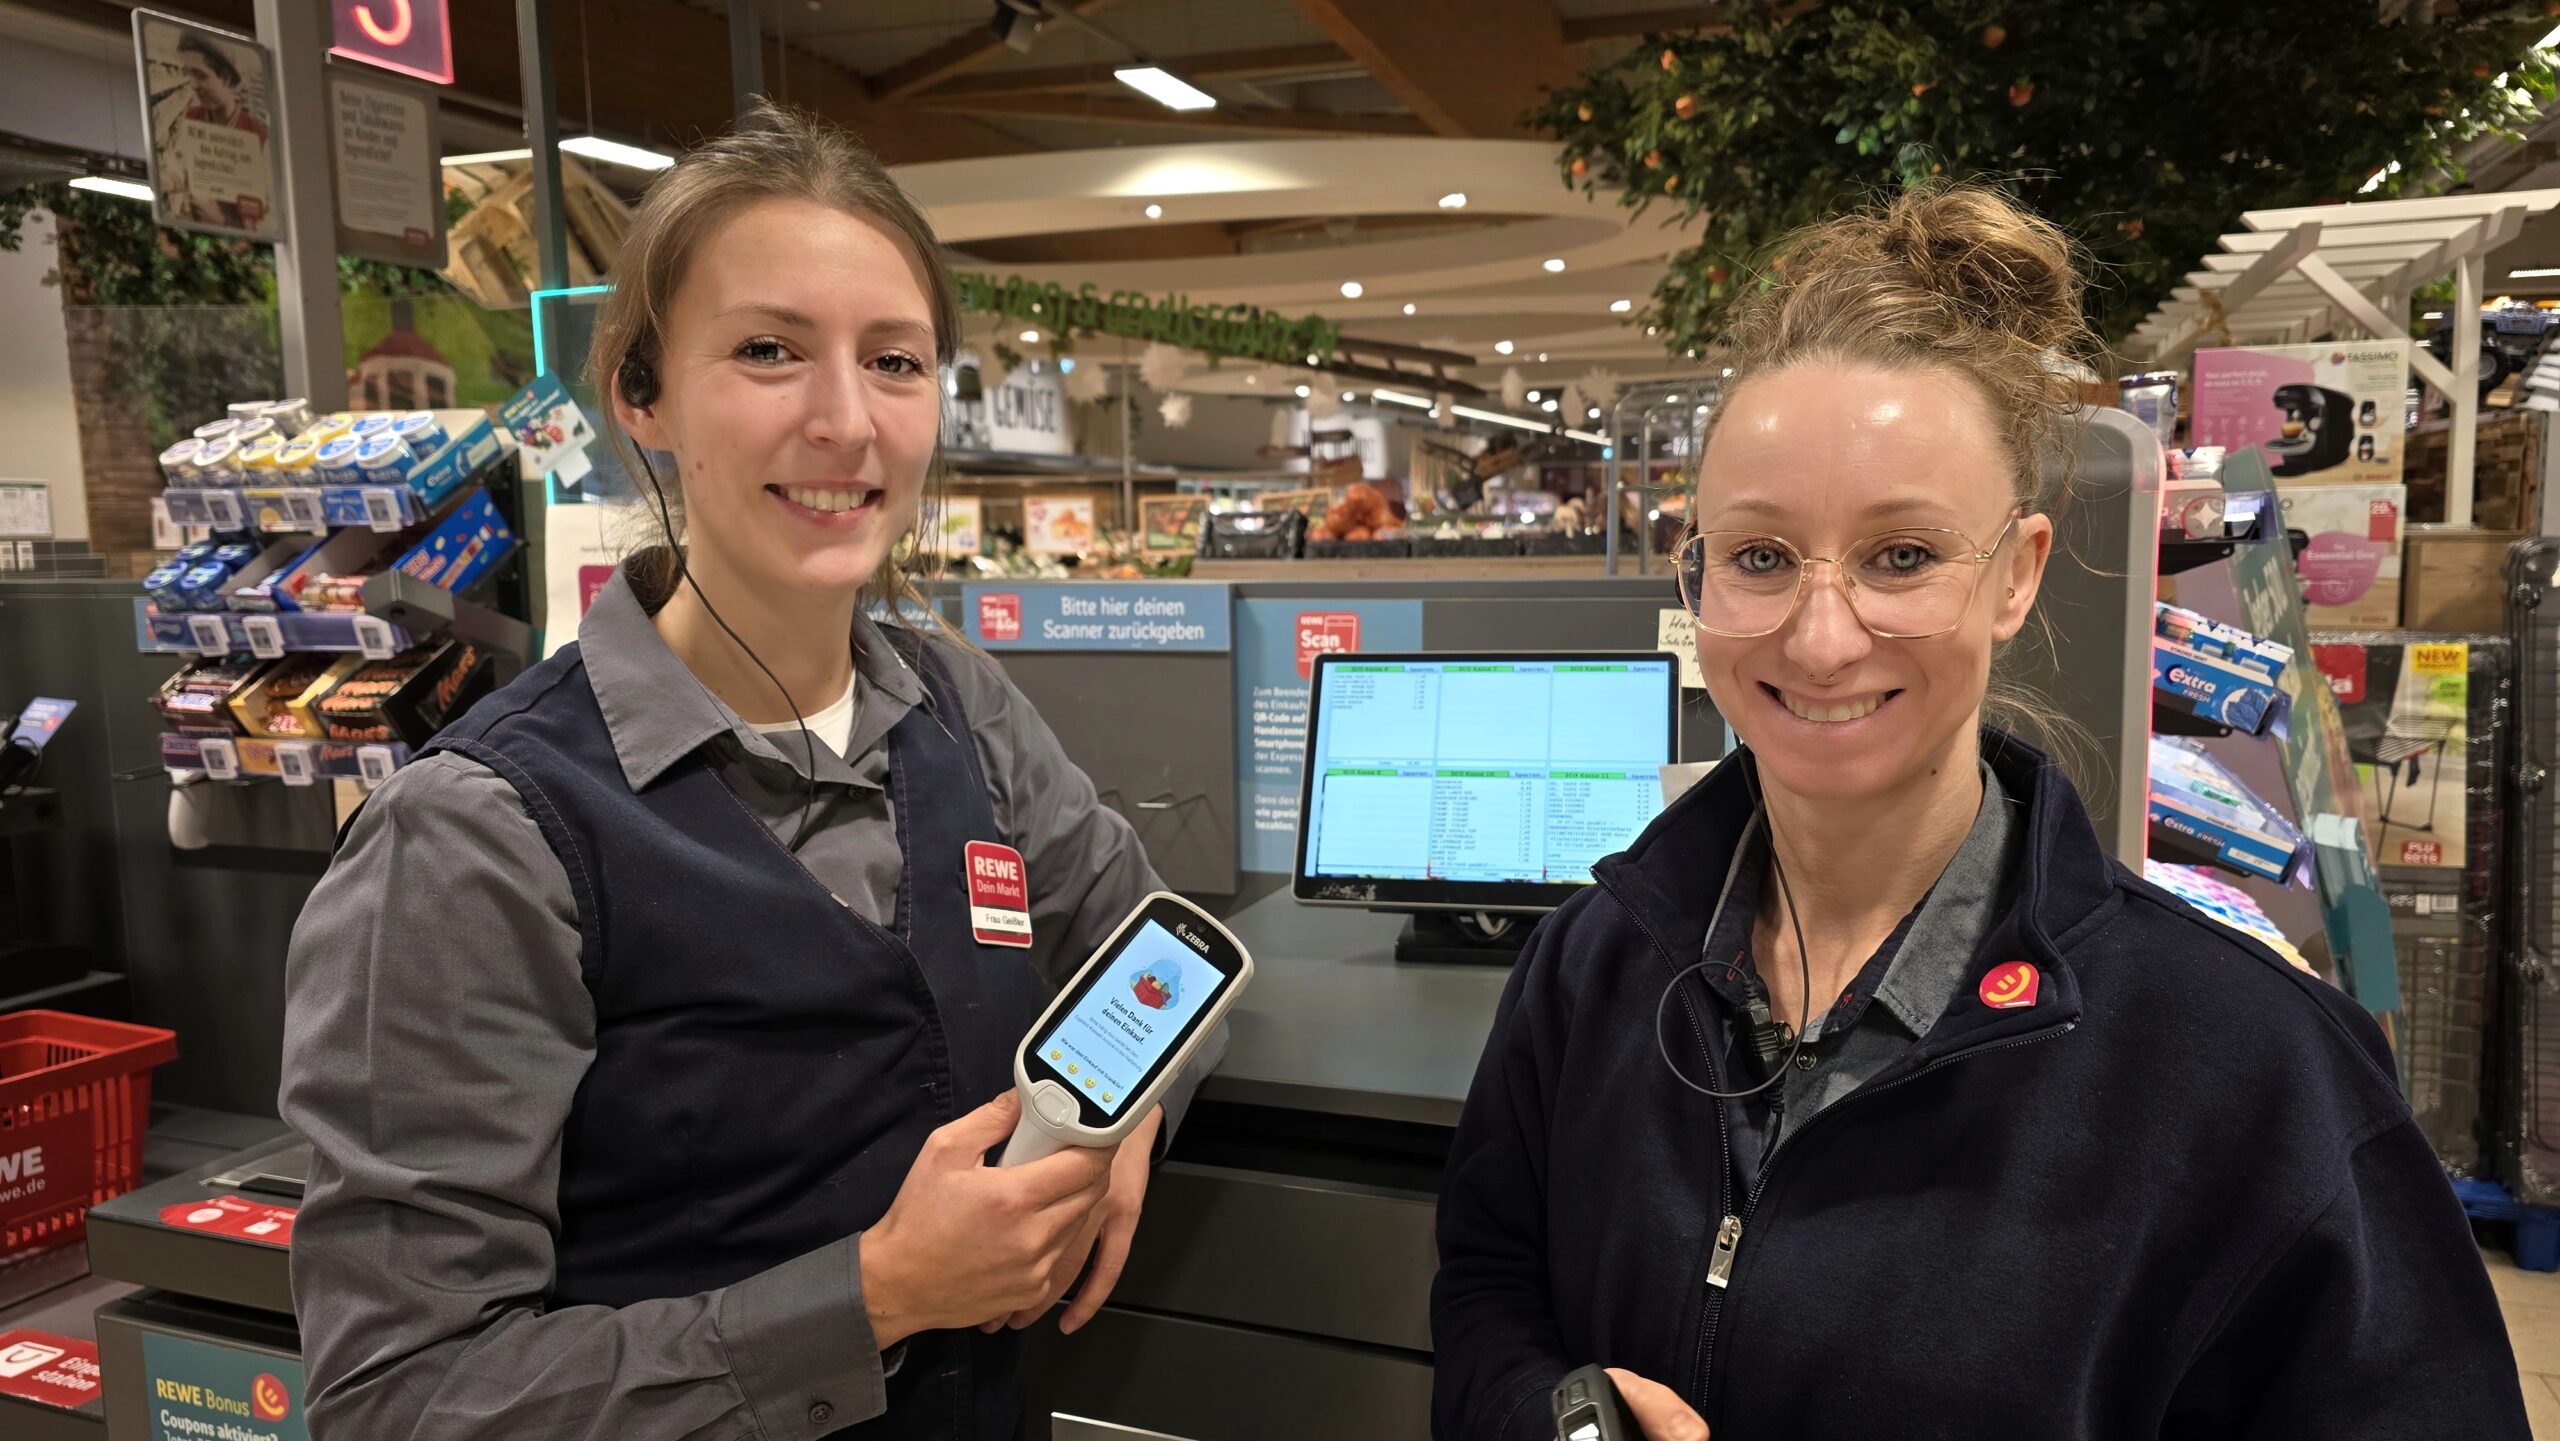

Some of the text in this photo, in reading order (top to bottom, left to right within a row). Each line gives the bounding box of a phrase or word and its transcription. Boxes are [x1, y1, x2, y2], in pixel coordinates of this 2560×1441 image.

[2348, 351, 2399, 363] TASSIMO
[992, 383, 1056, 434] GEMÜSE
[1061, 596, 1185, 616] Bitte hier deinen
[1043, 619, 1205, 643] Scanner zurückgeben
[1300, 629, 1340, 649] Scan
[2416, 649, 2460, 663] NEW
[2169, 667, 2217, 693] extra
[2182, 689, 2211, 703] FRESH
[1254, 711, 1290, 723] QR-Code
[2164, 816, 2194, 836] extra
[974, 856, 1019, 881] REWE
[976, 879, 1021, 898] Dein Markt
[986, 913, 1001, 924] Frau
[1184, 931, 1211, 954] ZEBRA
[1109, 996, 1154, 1035] Vielen Dank für
[1100, 1007, 1146, 1045] deinen Einkauf.
[1082, 1055, 1098, 1070] Einkauf
[156, 1377, 250, 1417] REWE Bonus
[160, 1409, 215, 1437] Coupons
